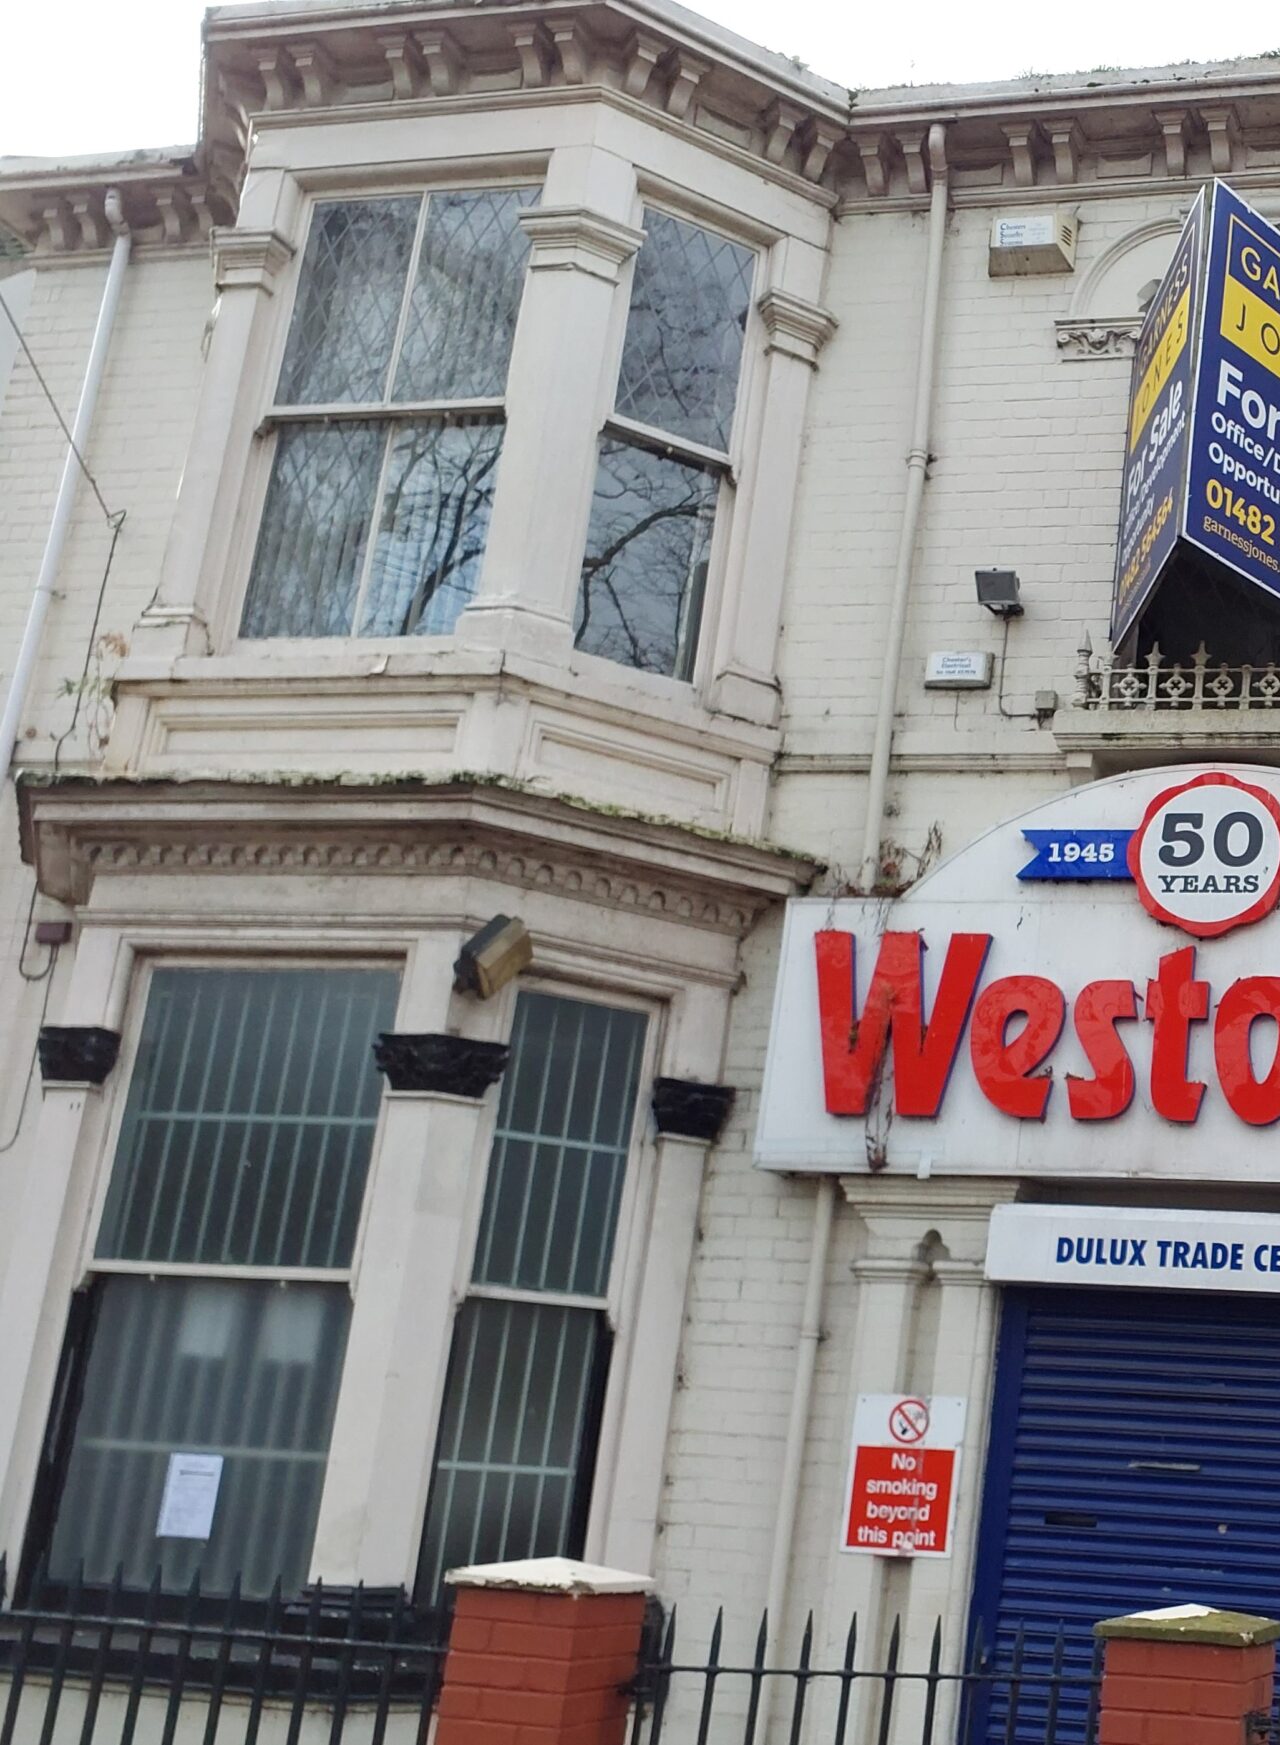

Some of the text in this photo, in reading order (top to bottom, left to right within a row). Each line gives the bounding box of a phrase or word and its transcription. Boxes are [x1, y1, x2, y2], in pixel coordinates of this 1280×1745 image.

[1127, 380, 1183, 513] For Sale
[1205, 478, 1276, 546] 01482
[1158, 811, 1264, 868] 50
[1047, 842, 1115, 863] 1945
[1158, 875, 1260, 894] YEARS
[1056, 1237, 1148, 1267] DULUX
[1157, 1240, 1244, 1270] TRADE
[891, 1452, 917, 1471] No
[866, 1478, 938, 1501] smoking
[866, 1500, 931, 1524] beyond
[857, 1525, 937, 1548] this point
